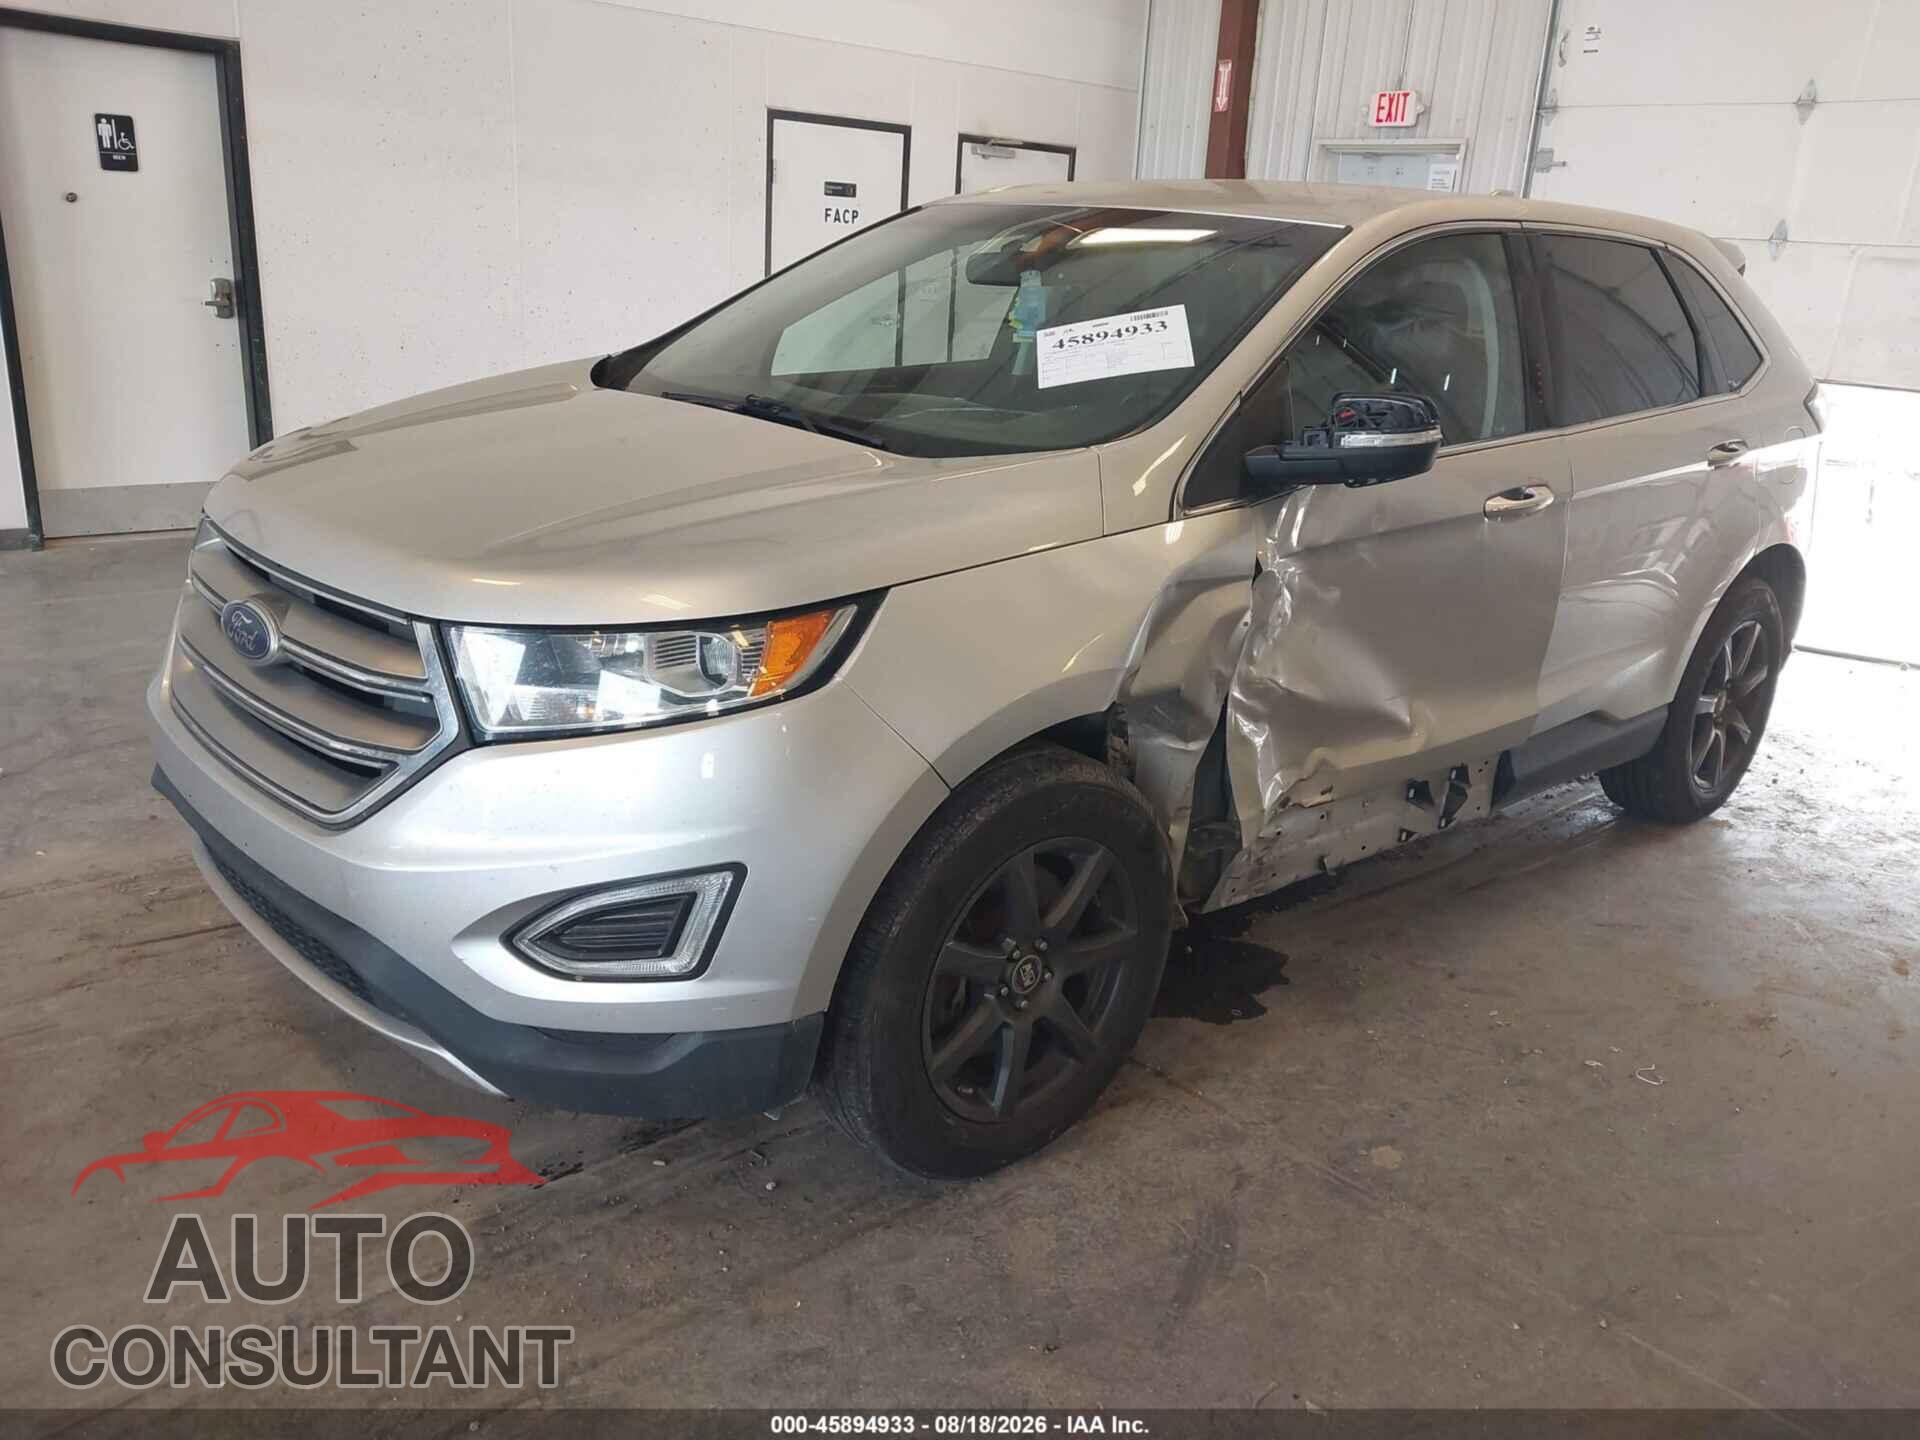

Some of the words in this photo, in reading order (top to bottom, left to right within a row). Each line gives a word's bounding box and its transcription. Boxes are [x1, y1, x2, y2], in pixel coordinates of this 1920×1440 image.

[1376, 93, 1410, 122] EXIT
[824, 208, 859, 224] FACP
[1052, 320, 1168, 350] 45894933
